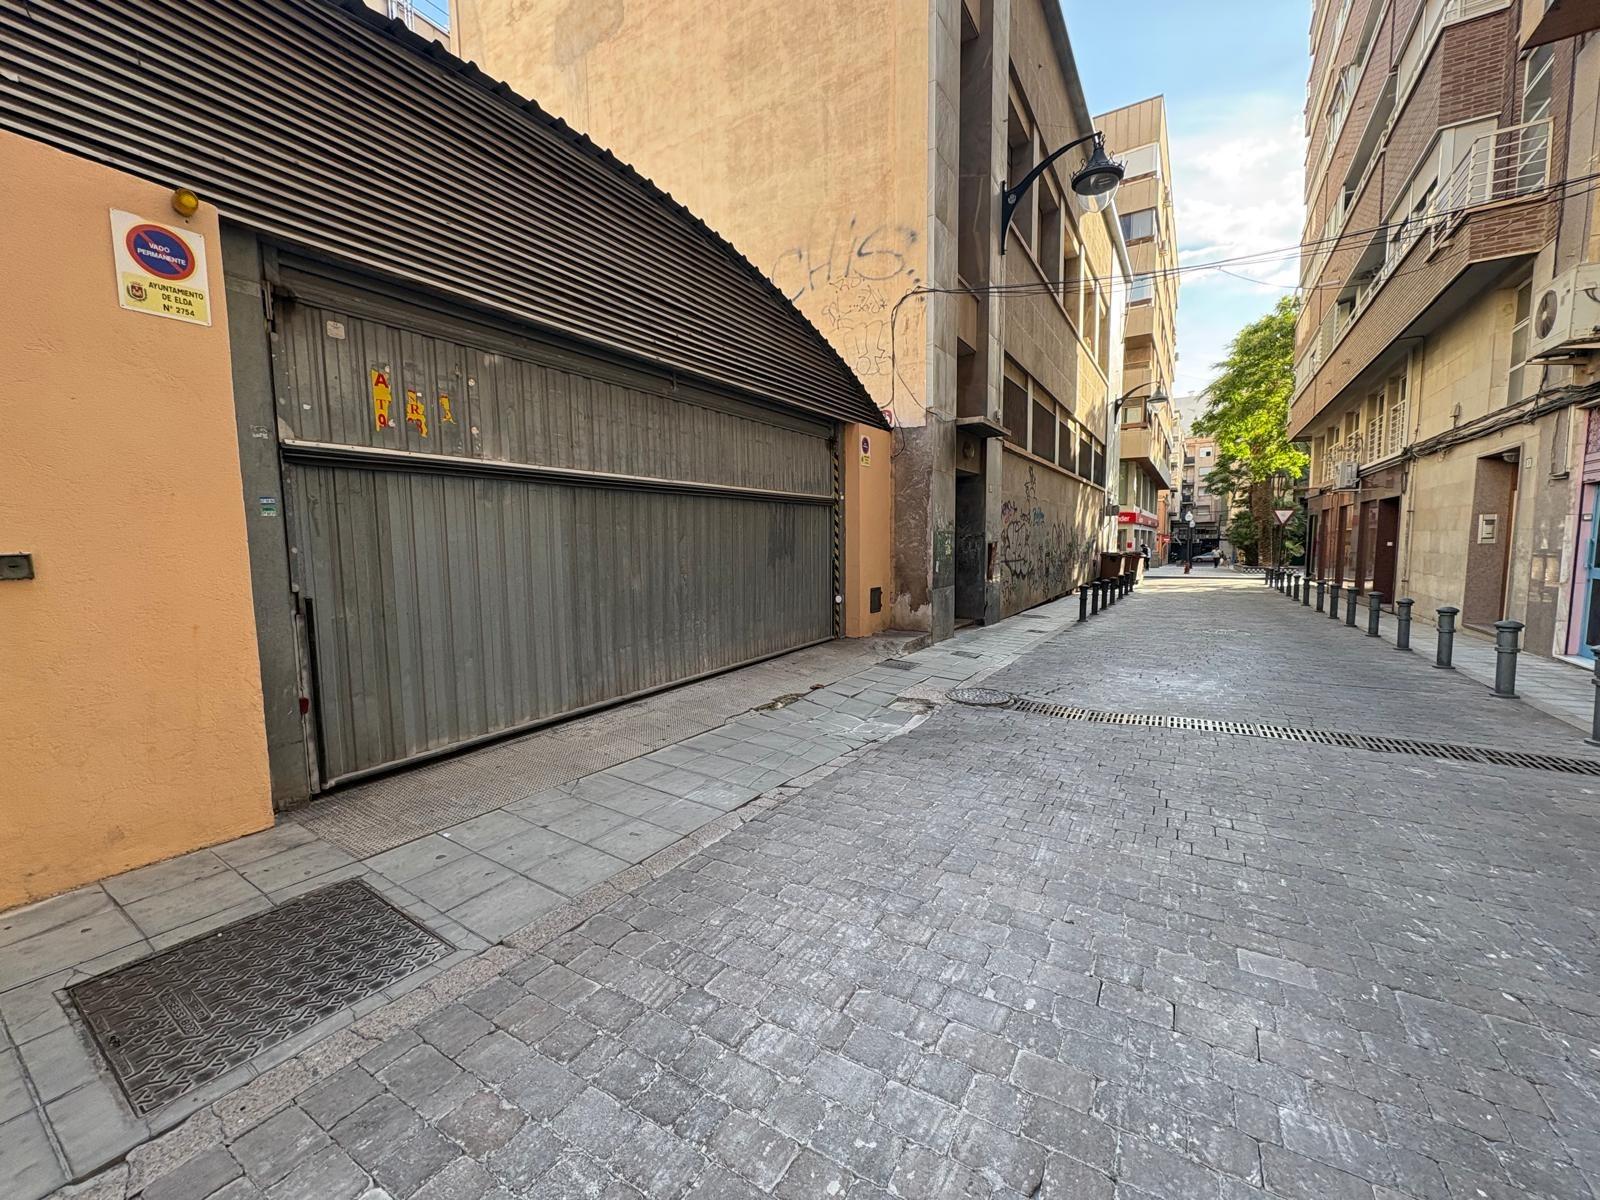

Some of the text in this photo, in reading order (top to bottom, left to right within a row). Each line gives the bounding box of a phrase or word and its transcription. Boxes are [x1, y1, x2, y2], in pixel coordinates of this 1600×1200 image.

[148, 242, 171, 254] VADO
[137, 247, 187, 266] PERMANENTE
[148, 281, 204, 300] AYUNTAMIENTO
[161, 293, 193, 306] DE ELDA
[175, 306, 195, 317] 2754
